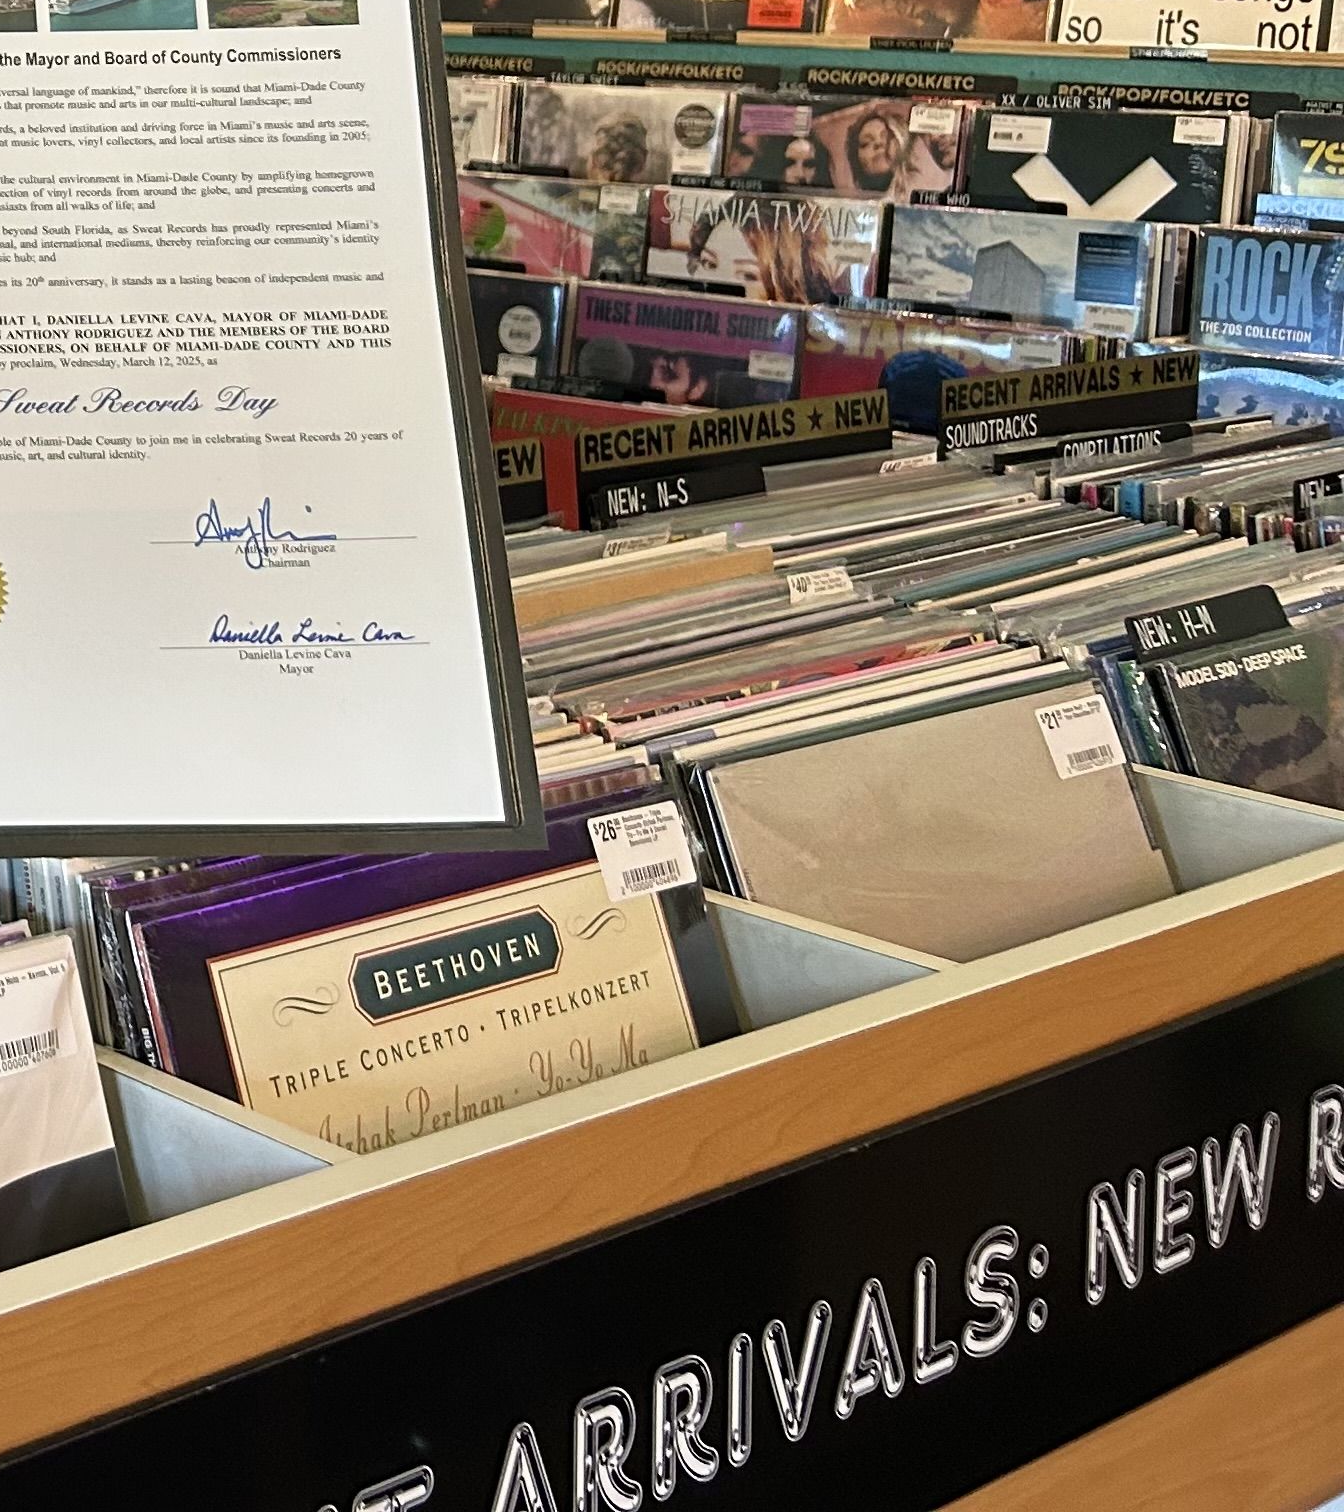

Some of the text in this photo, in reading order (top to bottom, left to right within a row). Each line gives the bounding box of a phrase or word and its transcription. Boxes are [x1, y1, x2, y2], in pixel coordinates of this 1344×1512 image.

[1065, 10, 1313, 53] so it's not
[25, 51, 70, 70] Mayor
[73, 50, 100, 66] and
[104, 50, 148, 65] Board
[151, 49, 167, 65] of
[169, 49, 223, 67] County
[226, 46, 342, 63] Commissioners
[596, 60, 744, 81] ROCK/POP/FOLK/ETC
[807, 68, 975, 91] ROCK/POP/FOLK/ETC
[1001, 93, 1016, 107] XX
[1036, 94, 1081, 109] OLIVER
[1088, 96, 1112, 110] SIM
[662, 194, 867, 239] SHANIA TWAIN
[918, 191, 970, 206] THE WHO
[1201, 236, 1323, 327] ROCK
[6, 329, 70, 340] ANTHONY
[74, 327, 154, 340] RODRIGUEZ
[157, 327, 185, 338] AND
[187, 326, 216, 338] THE
[219, 325, 286, 337] MEMBERS
[289, 325, 308, 336] OF
[311, 324, 340, 336] THE
[342, 323, 390, 335] BOARD
[32, 315, 41, 327] I,
[46, 314, 114, 326] DANIELLA
[120, 313, 170, 325] LEVINE
[175, 312, 217, 325] CAVA,
[222, 311, 274, 323] MAYOR
[278, 311, 298, 322] OF
[303, 309, 388, 321] MIAMI-DADE
[586, 296, 630, 324] THESE
[635, 302, 720, 336] IMMORTAL
[1199, 320, 1312, 344] THE 70S COLLECTION
[70, 342, 90, 354] ON
[94, 342, 148, 353] BEHALF
[152, 341, 171, 353] OF
[175, 340, 261, 352] MIAMI-DADE
[264, 339, 321, 351] COUNTY
[326, 338, 355, 349] AND
[360, 337, 392, 349] THIS
[82, 386, 203, 414] Records
[214, 385, 279, 420] Day
[945, 356, 1198, 414] RECENT ARRIVALS NEW
[584, 395, 885, 465] RECENT ARRIVALS NEW
[945, 413, 1038, 449] SOUNDTRACKS
[607, 478, 689, 517] NEW: N-S
[282, 542, 337, 556] Rodriguez
[1133, 604, 1217, 651] NEW: H-M
[238, 647, 352, 661] Daniella Levine Cava
[279, 663, 315, 677] Mayor
[1174, 643, 1308, 689] MODEL 500 DEEP SPACE
[373, 932, 542, 1000] BEETHOVEN
[269, 970, 652, 1098] TRIPLE CONCERTO TRIPELKONZERT
[404, 1085, 505, 1138] Perlman
[529, 1037, 604, 1097] Yo-Yo
[611, 1022, 650, 1073] Ma
[490, 1224, 1050, 1512] ARRIVALS:
[1085, 1110, 1281, 1306] NEW
